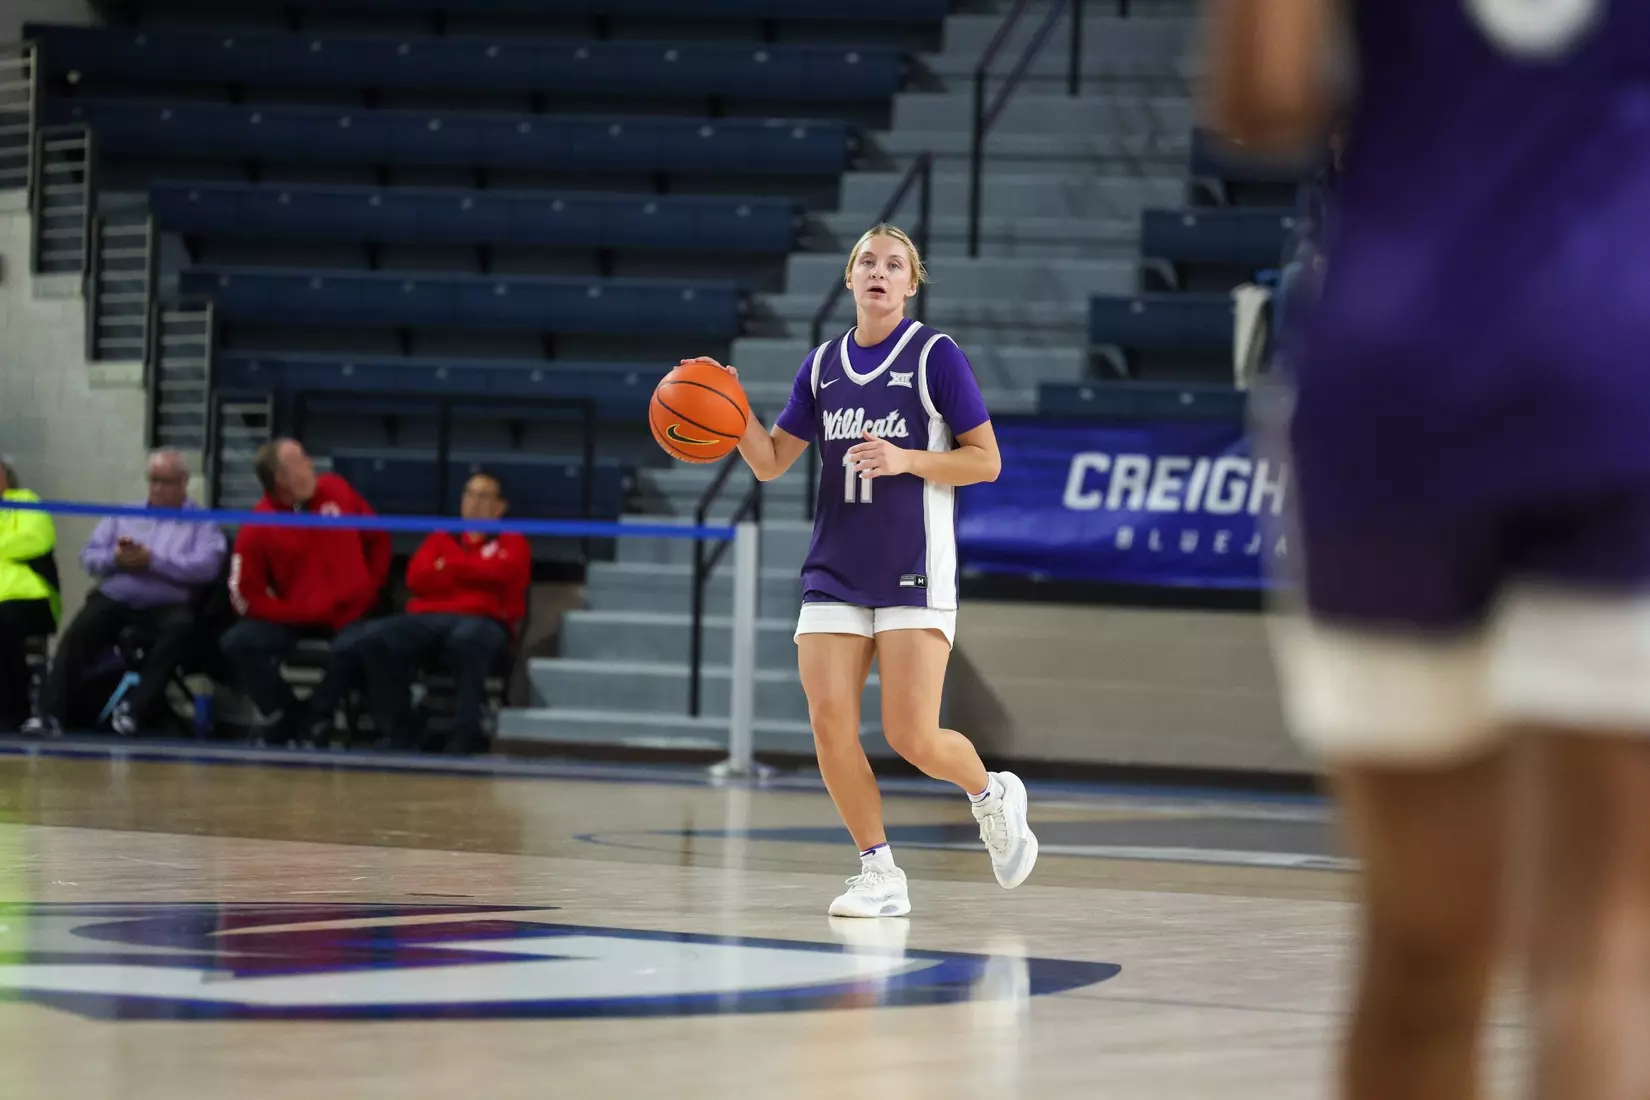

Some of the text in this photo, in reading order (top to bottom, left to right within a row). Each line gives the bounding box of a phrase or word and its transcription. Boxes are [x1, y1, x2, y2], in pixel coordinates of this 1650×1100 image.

[822, 407, 910, 441] Wildcats
[842, 448, 873, 504] 11
[1063, 451, 1288, 516] CREIGH
